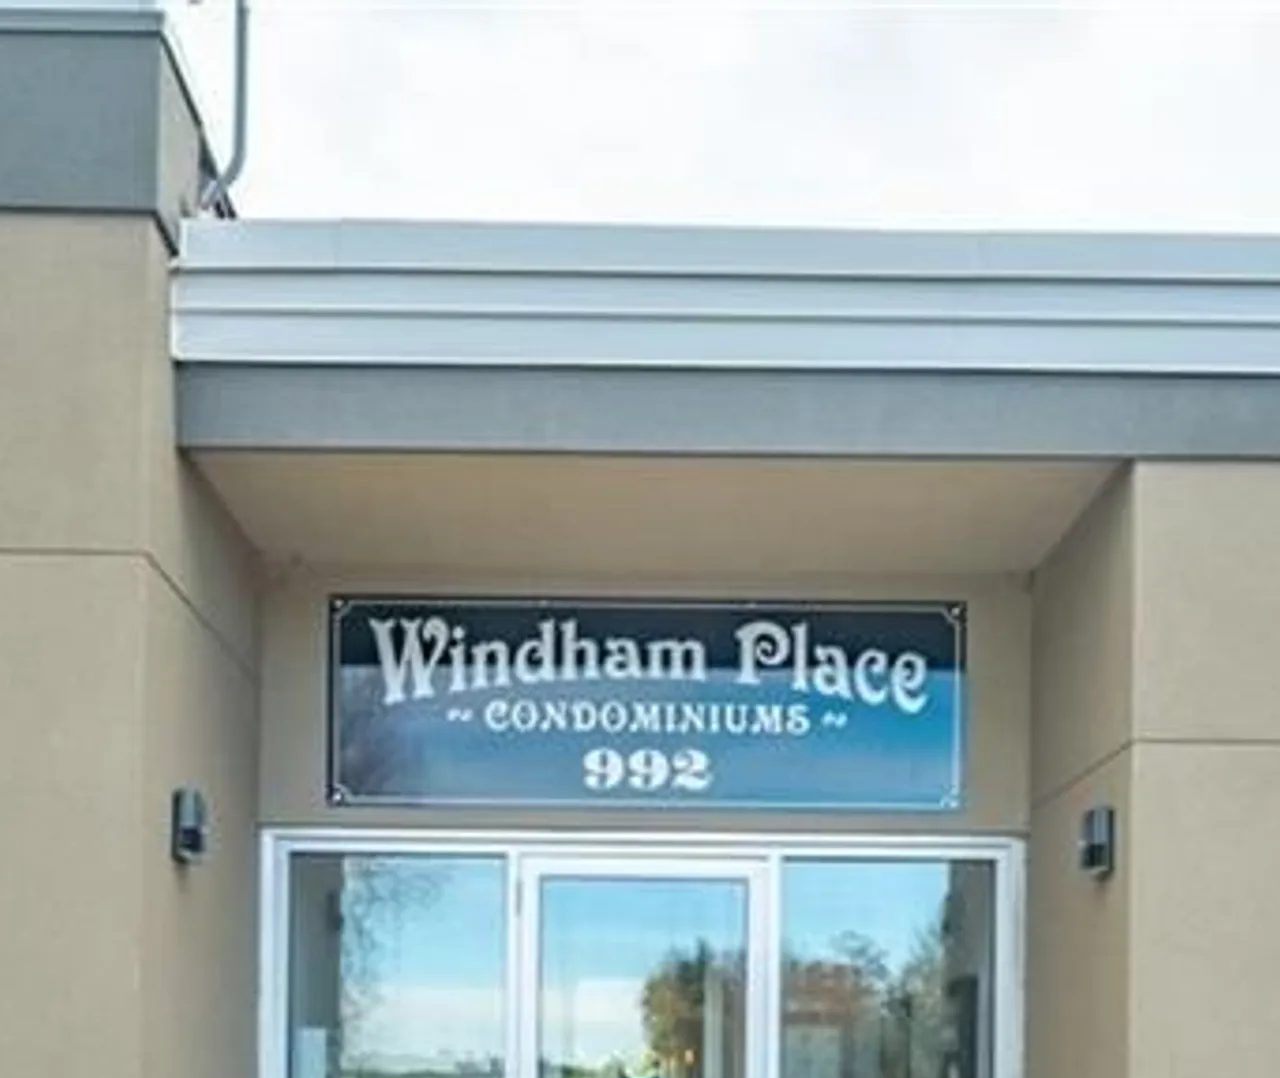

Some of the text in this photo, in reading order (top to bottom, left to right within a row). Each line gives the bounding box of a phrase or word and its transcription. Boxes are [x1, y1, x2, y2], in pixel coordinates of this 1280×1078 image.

[370, 617, 927, 712] Windham Place
[484, 703, 810, 735] CONDOMINIUMS
[583, 748, 712, 790] 992
